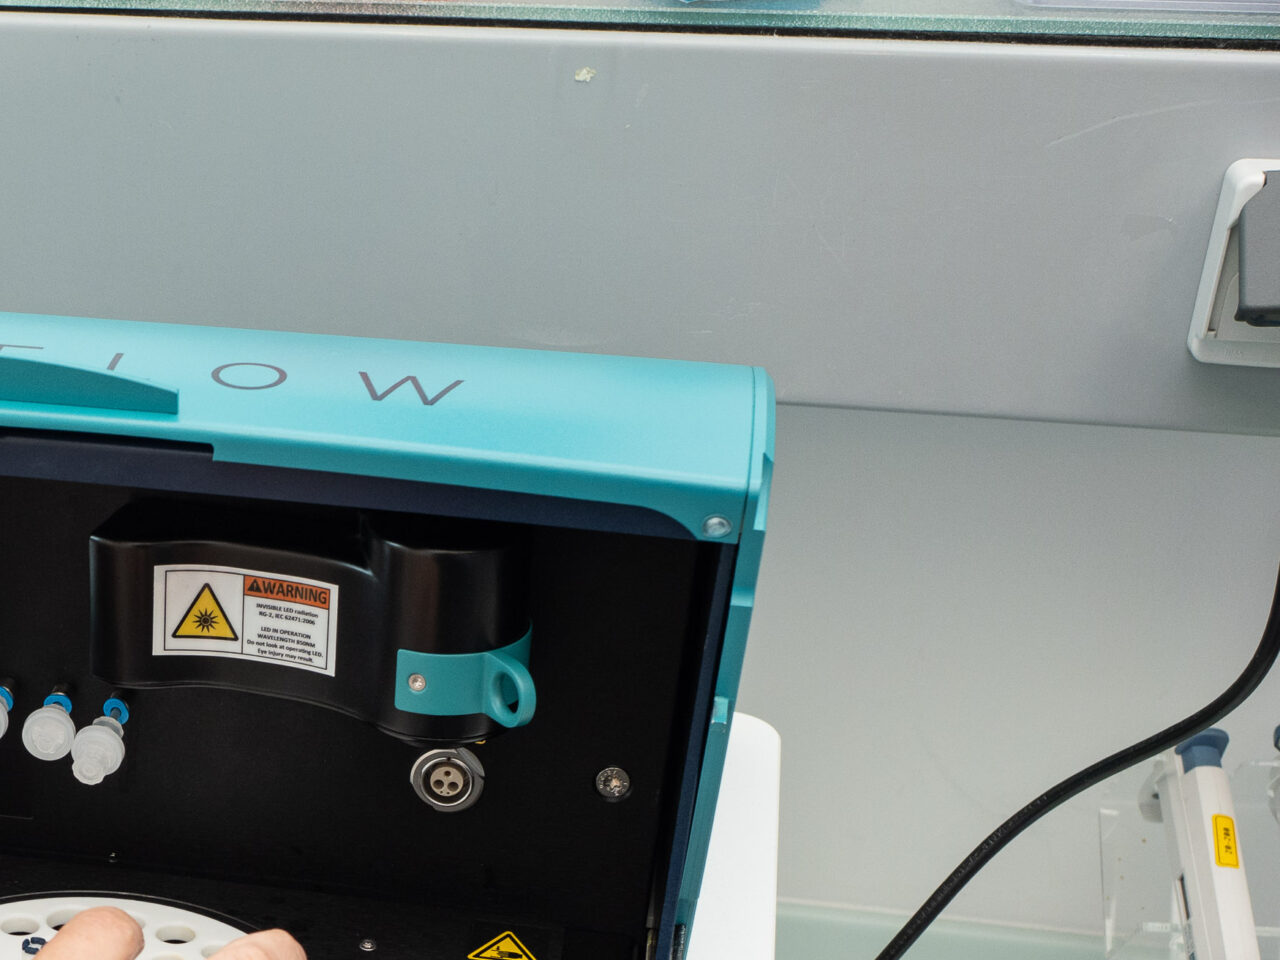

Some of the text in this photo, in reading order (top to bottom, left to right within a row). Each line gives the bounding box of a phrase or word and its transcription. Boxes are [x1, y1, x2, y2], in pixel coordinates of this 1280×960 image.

[262, 580, 327, 604] WARNING
[256, 603, 282, 612] INVISIBLE
[294, 609, 319, 619] radiation
[257, 634, 296, 644] WAVELENGTH
[279, 629, 312, 640] OPERATION
[268, 650, 284, 658] injury
[286, 646, 312, 656] operating
